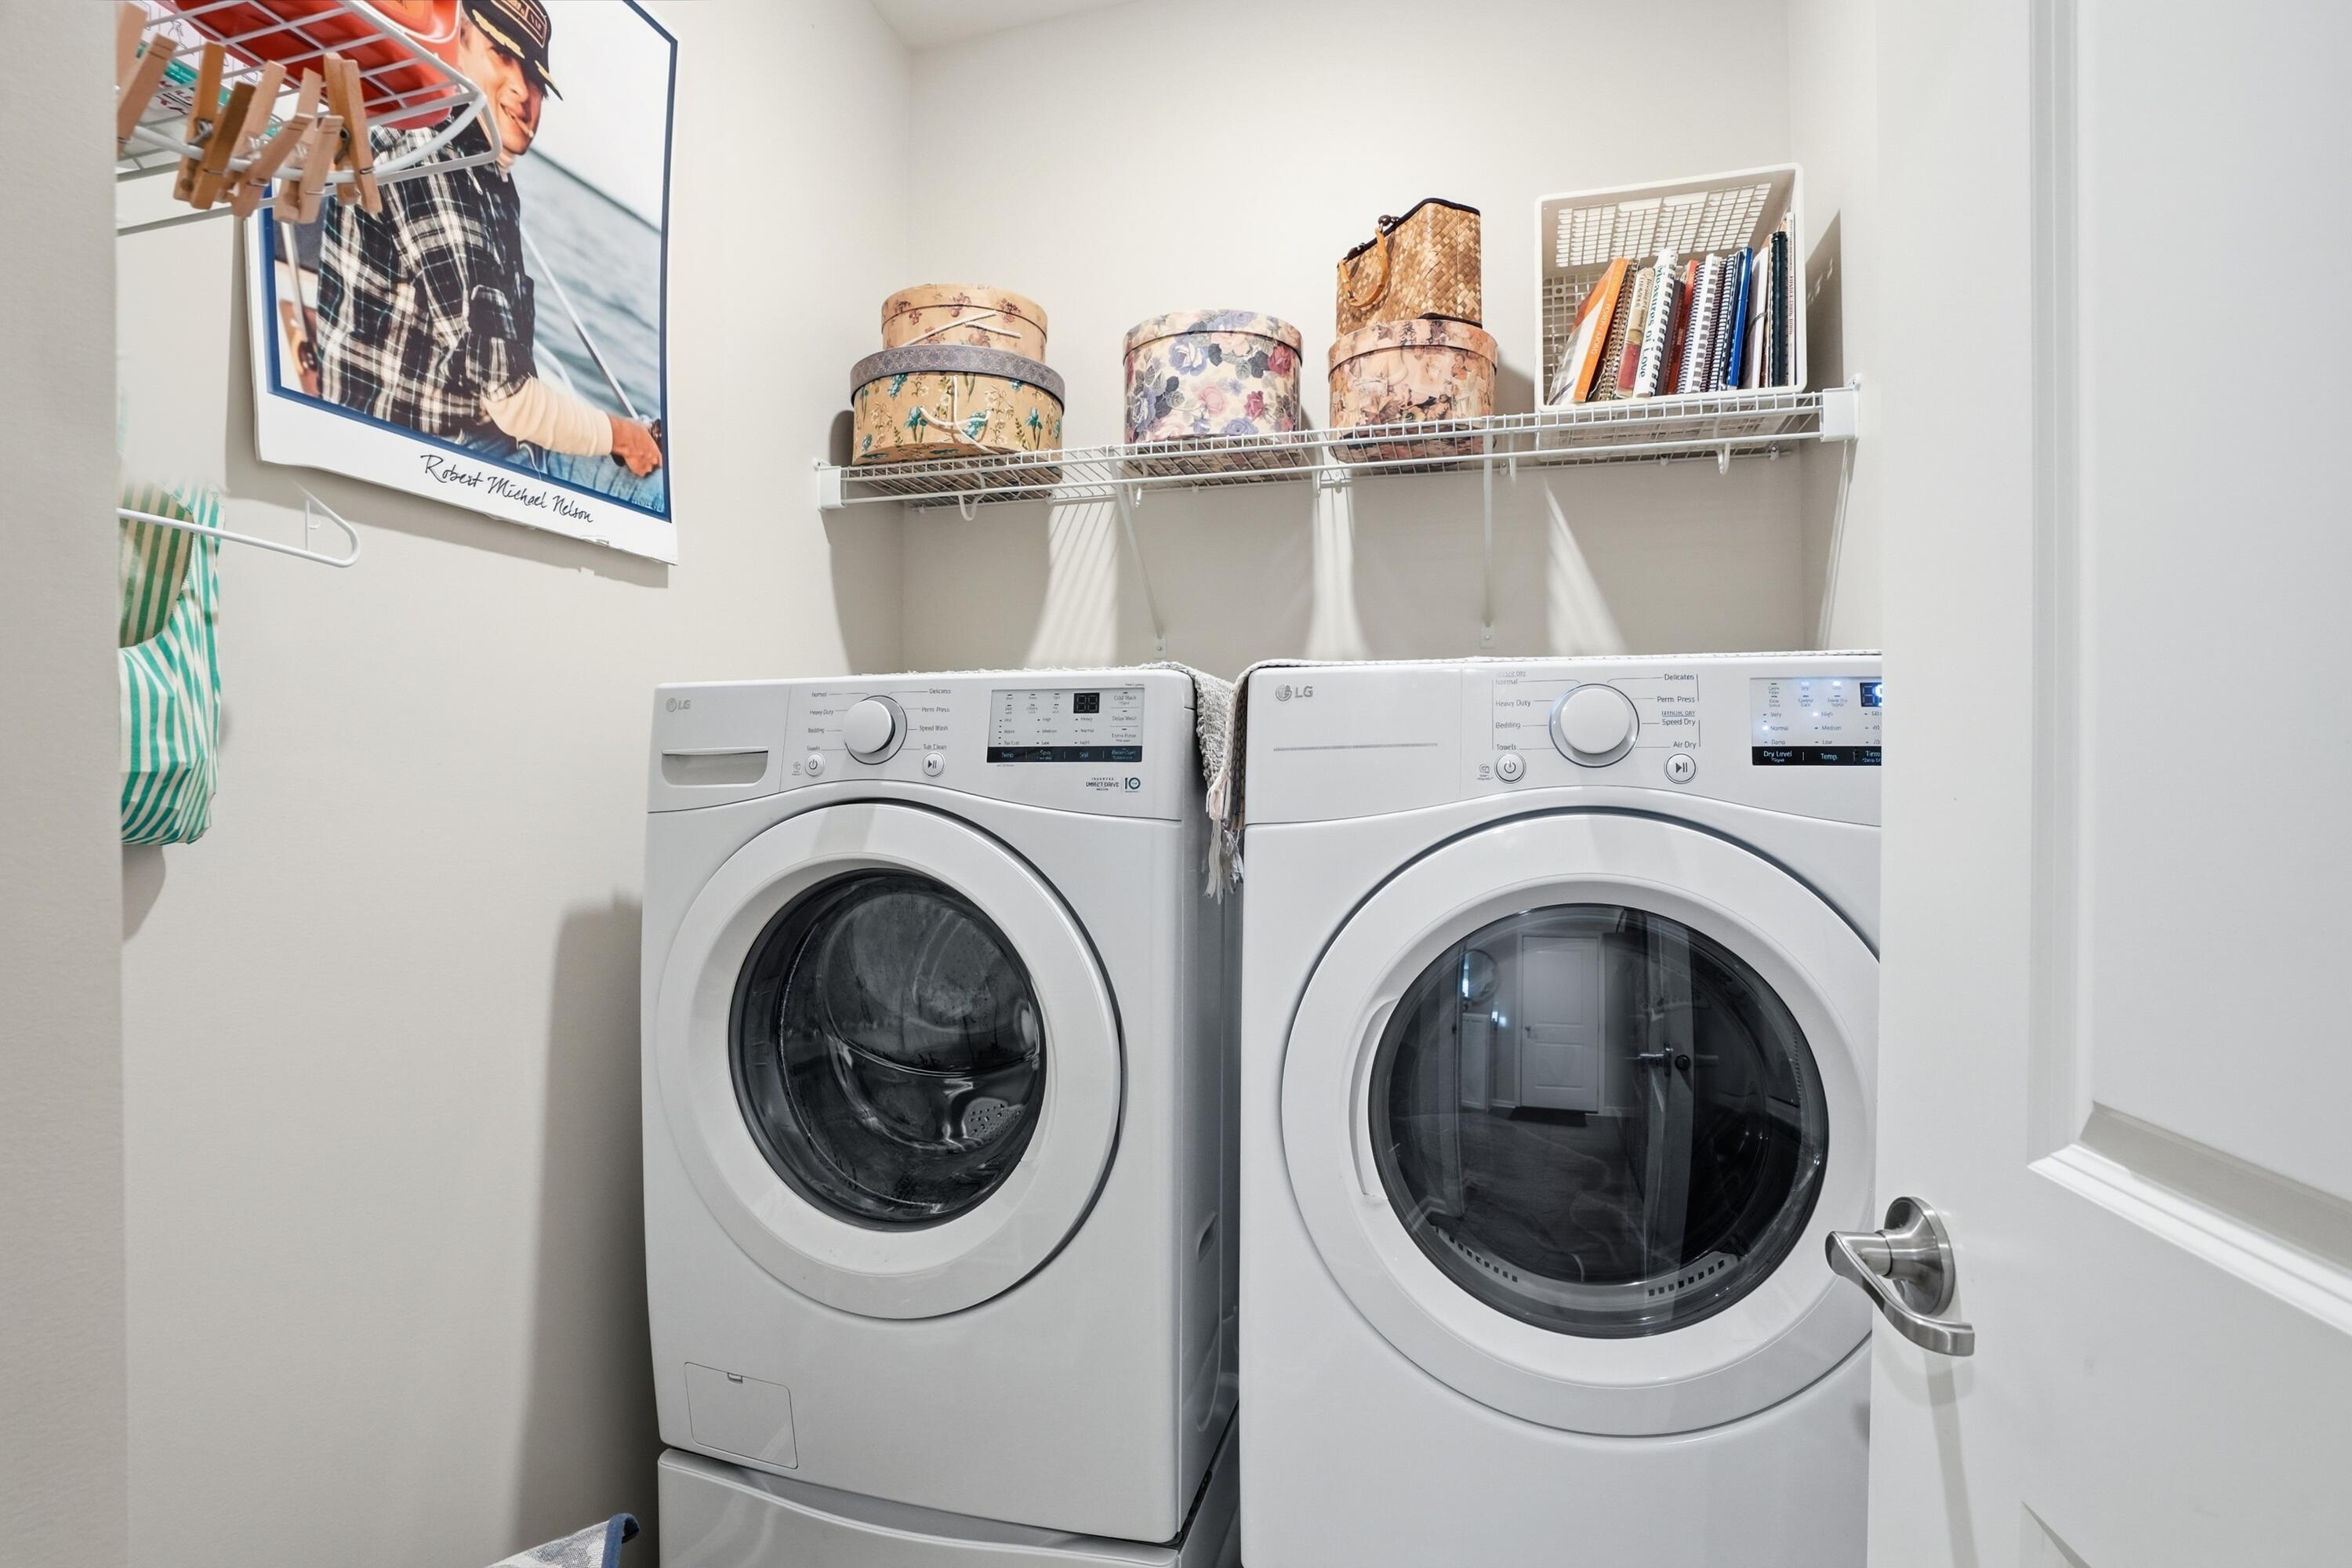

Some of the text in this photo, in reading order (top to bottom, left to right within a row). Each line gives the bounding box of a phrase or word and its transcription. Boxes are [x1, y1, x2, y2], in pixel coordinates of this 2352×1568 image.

[1645, 330, 1654, 343] of
[1639, 347, 1653, 378] Love
[420, 454, 593, 523] Robert Michael Nelson
[1294, 685, 1313, 698] LG
[678, 699, 691, 710] LG
[1495, 721, 1521, 730] Bedding
[1684, 740, 1697, 750] Dry
[1763, 750, 1775, 759] Dry
